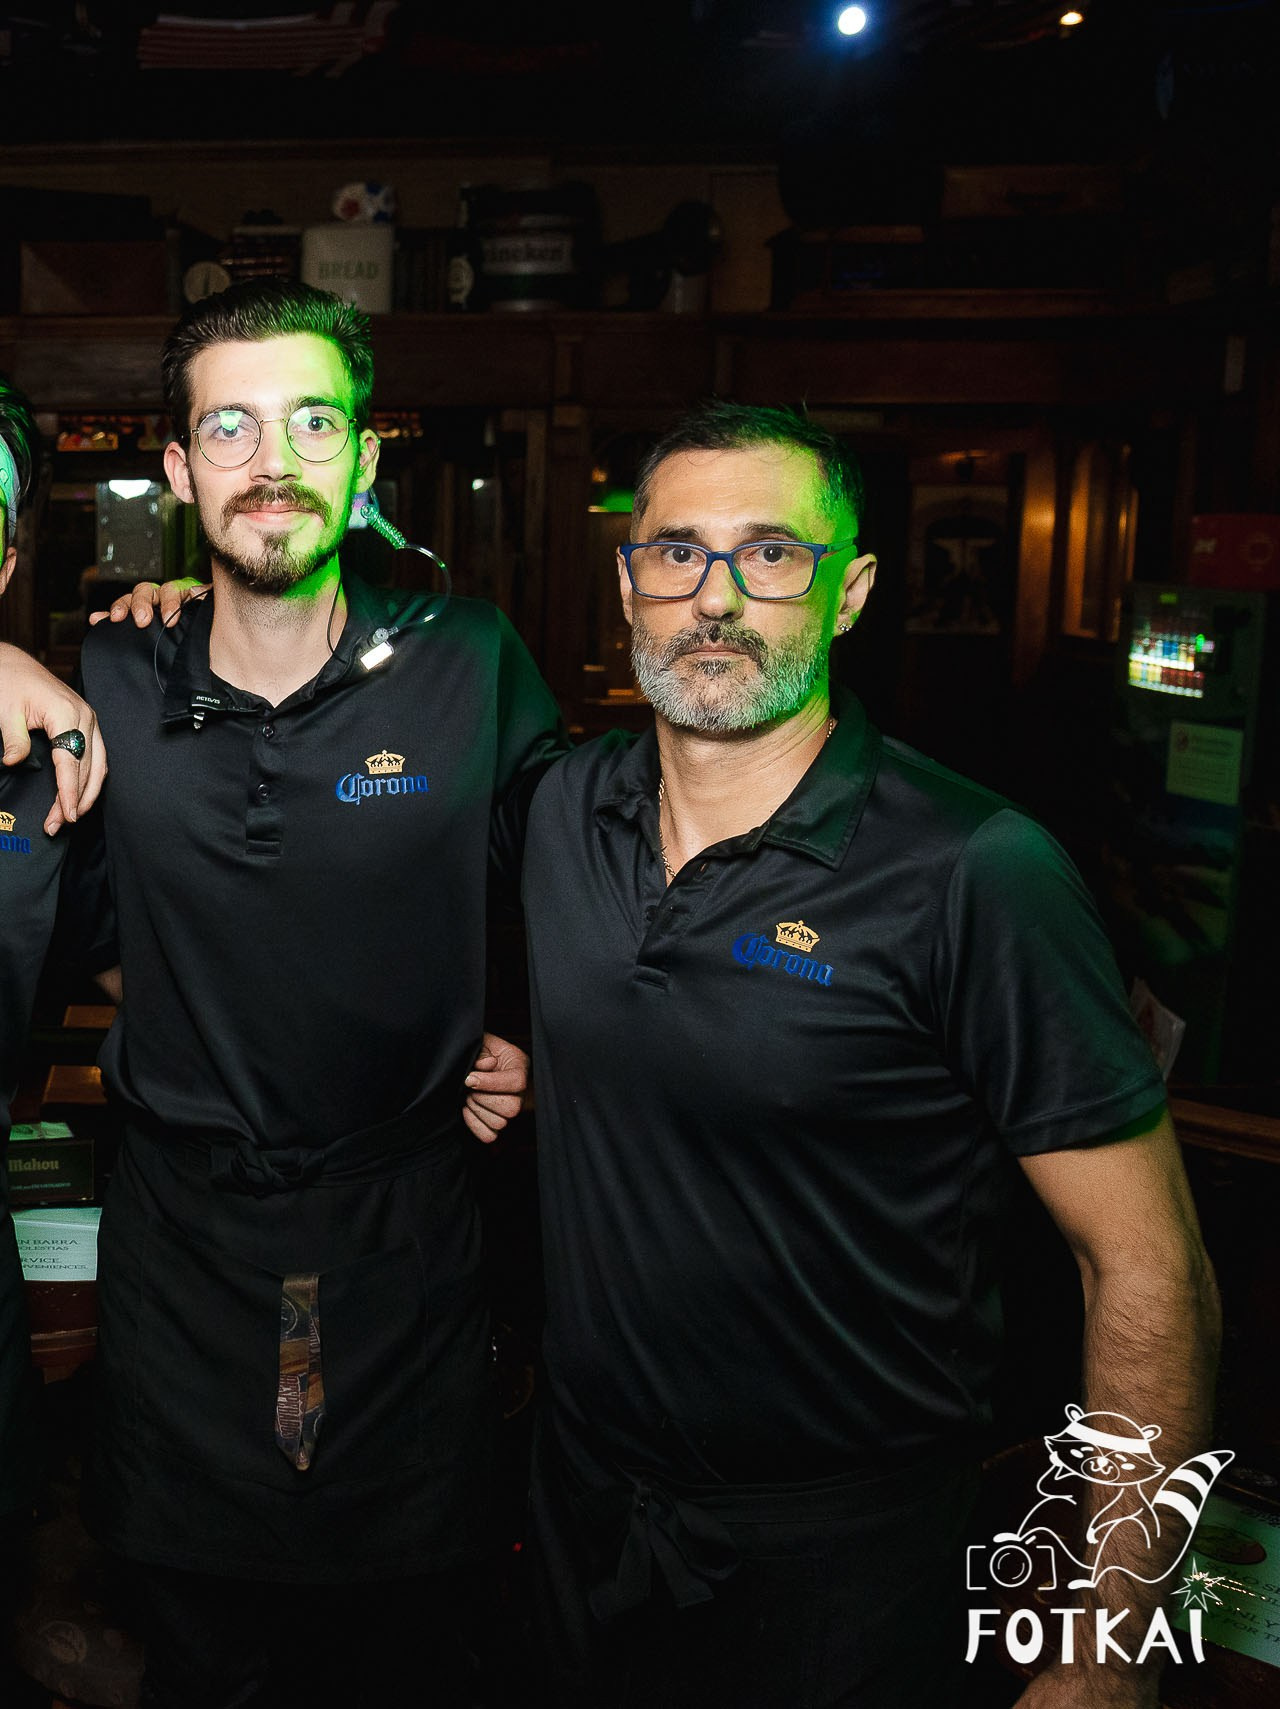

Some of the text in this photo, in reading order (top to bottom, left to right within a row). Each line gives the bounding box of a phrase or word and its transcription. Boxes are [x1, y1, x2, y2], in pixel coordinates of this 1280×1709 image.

[335, 773, 429, 805] Corona
[732, 933, 834, 987] Corona
[8, 1158, 60, 1172] Mahou
